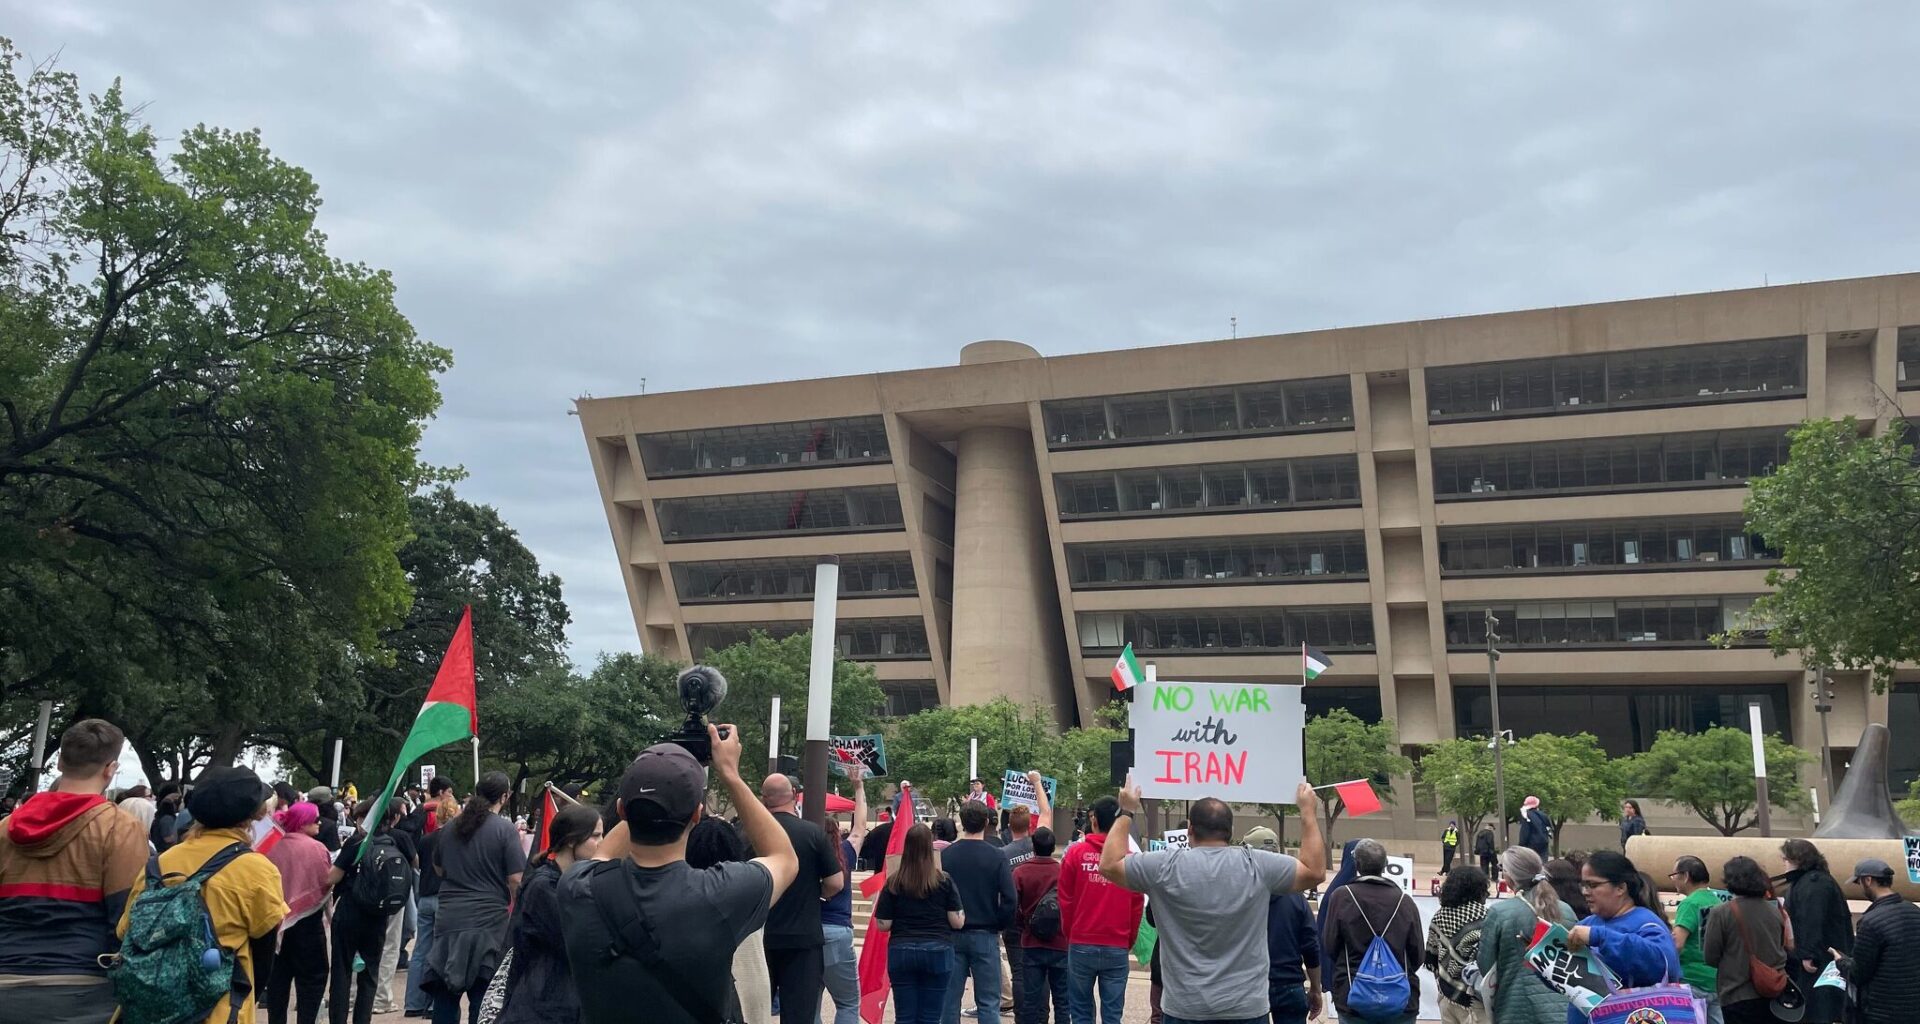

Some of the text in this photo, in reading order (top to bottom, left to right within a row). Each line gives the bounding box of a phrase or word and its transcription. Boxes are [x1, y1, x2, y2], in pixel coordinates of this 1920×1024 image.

[1153, 686, 1271, 713] NO WAR
[1171, 716, 1237, 745] with
[829, 738, 876, 750] UCHAMOS
[1155, 750, 1247, 785] IRAN
[1006, 783, 1036, 794] POR LOS
[1007, 774, 1052, 790] LUCHOS
